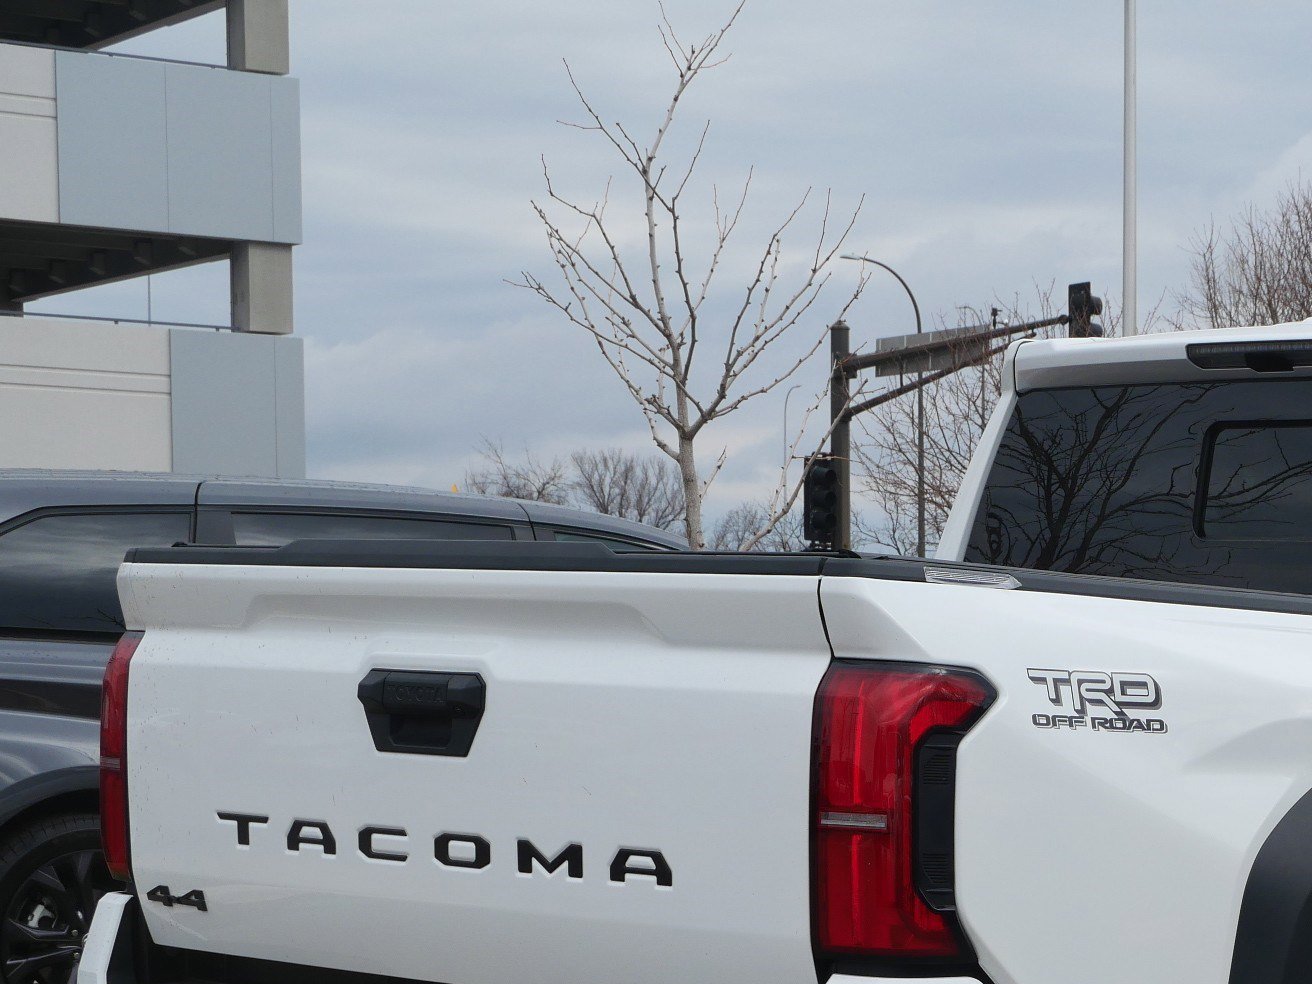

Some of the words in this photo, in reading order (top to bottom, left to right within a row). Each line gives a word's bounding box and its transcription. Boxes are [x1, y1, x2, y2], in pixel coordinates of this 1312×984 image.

[1026, 668, 1163, 716] TRD
[1032, 713, 1086, 731] OFF
[1090, 716, 1168, 734] ROAD
[215, 811, 674, 889] TACOMA
